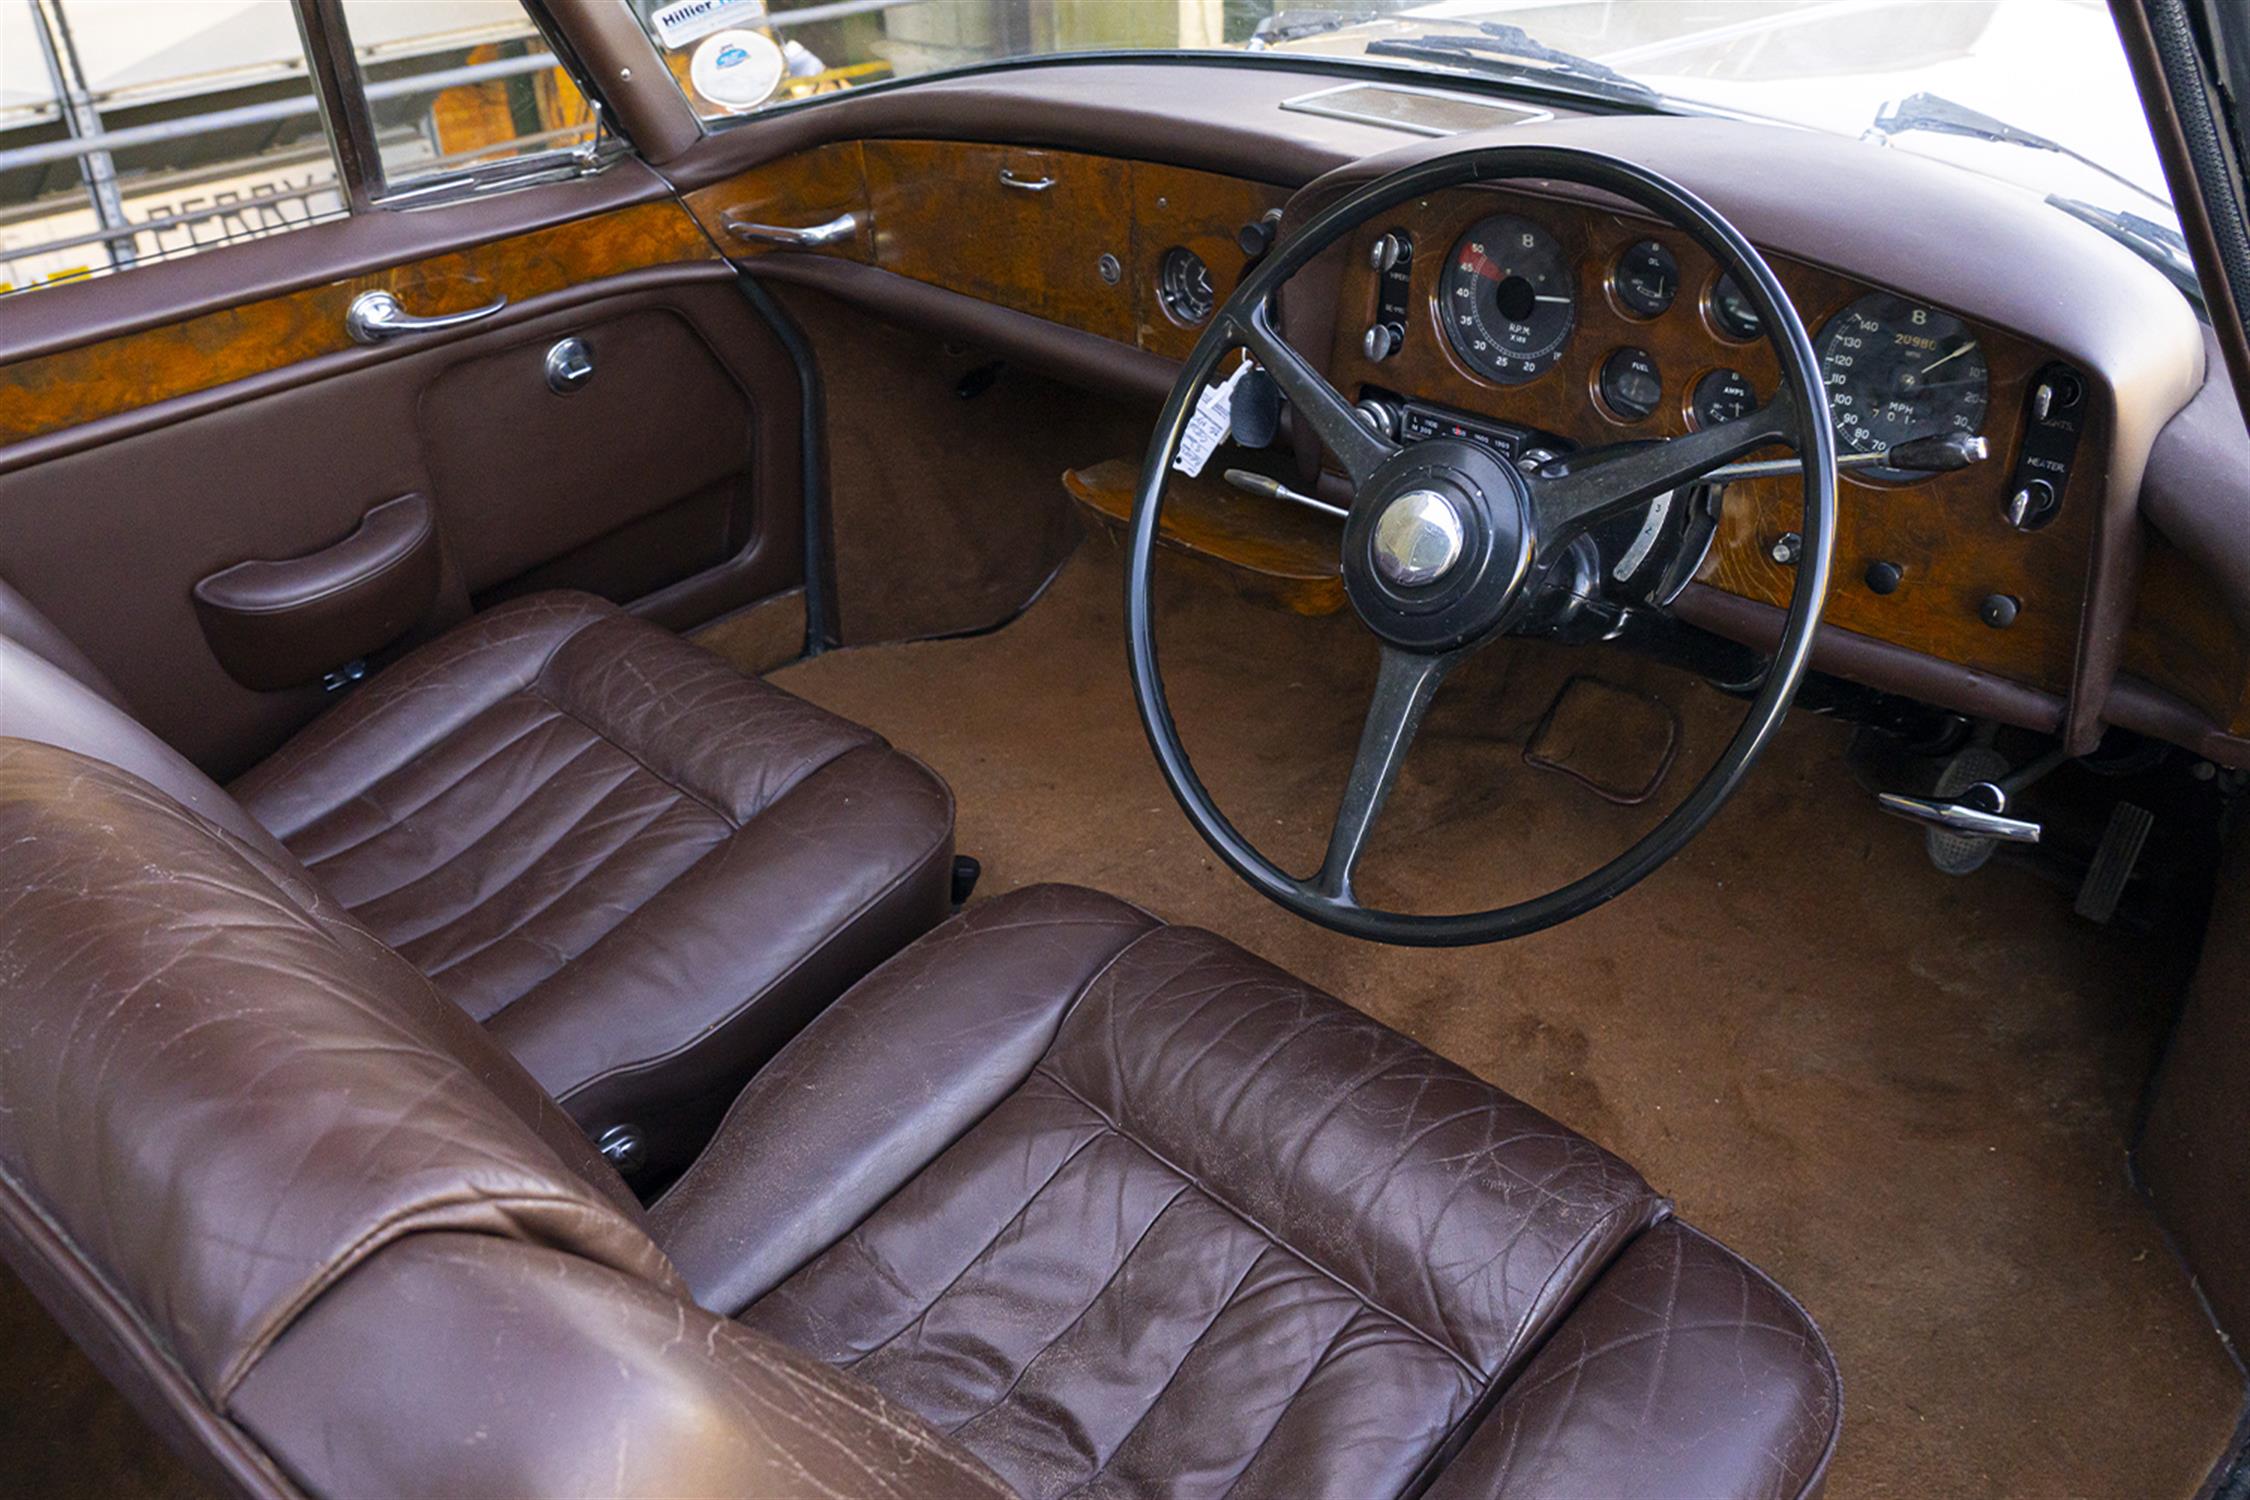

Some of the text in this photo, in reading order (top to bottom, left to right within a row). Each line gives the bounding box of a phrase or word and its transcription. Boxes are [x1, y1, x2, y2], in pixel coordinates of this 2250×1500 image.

[662, 0, 712, 26] Hillier
[1522, 233, 1534, 248] B
[1471, 242, 1485, 254] 50
[1460, 262, 1474, 273] 45
[1456, 287, 1470, 298] 40
[1459, 315, 1473, 327] 35
[1912, 309, 1927, 325] B
[1859, 320, 1880, 333] 140
[1473, 340, 1487, 351] 30
[1843, 336, 1862, 350] 130
[1496, 356, 1509, 368] 25
[1523, 361, 1536, 373] 20
[1632, 361, 1649, 373] FUEL
[1833, 355, 1854, 367] 120
[1969, 366, 1981, 379] 10
[1830, 373, 1847, 386] 110
[1723, 386, 1745, 397] AMPS
[1964, 391, 1980, 404] 20
[1834, 393, 1853, 407] 100
[1889, 401, 1914, 415] MPH
[1843, 412, 1859, 426] 90
[1953, 414, 1969, 428] 30
[1854, 428, 1870, 441] 80
[1871, 440, 1887, 451] 70
[2027, 456, 2065, 473] HEATER
